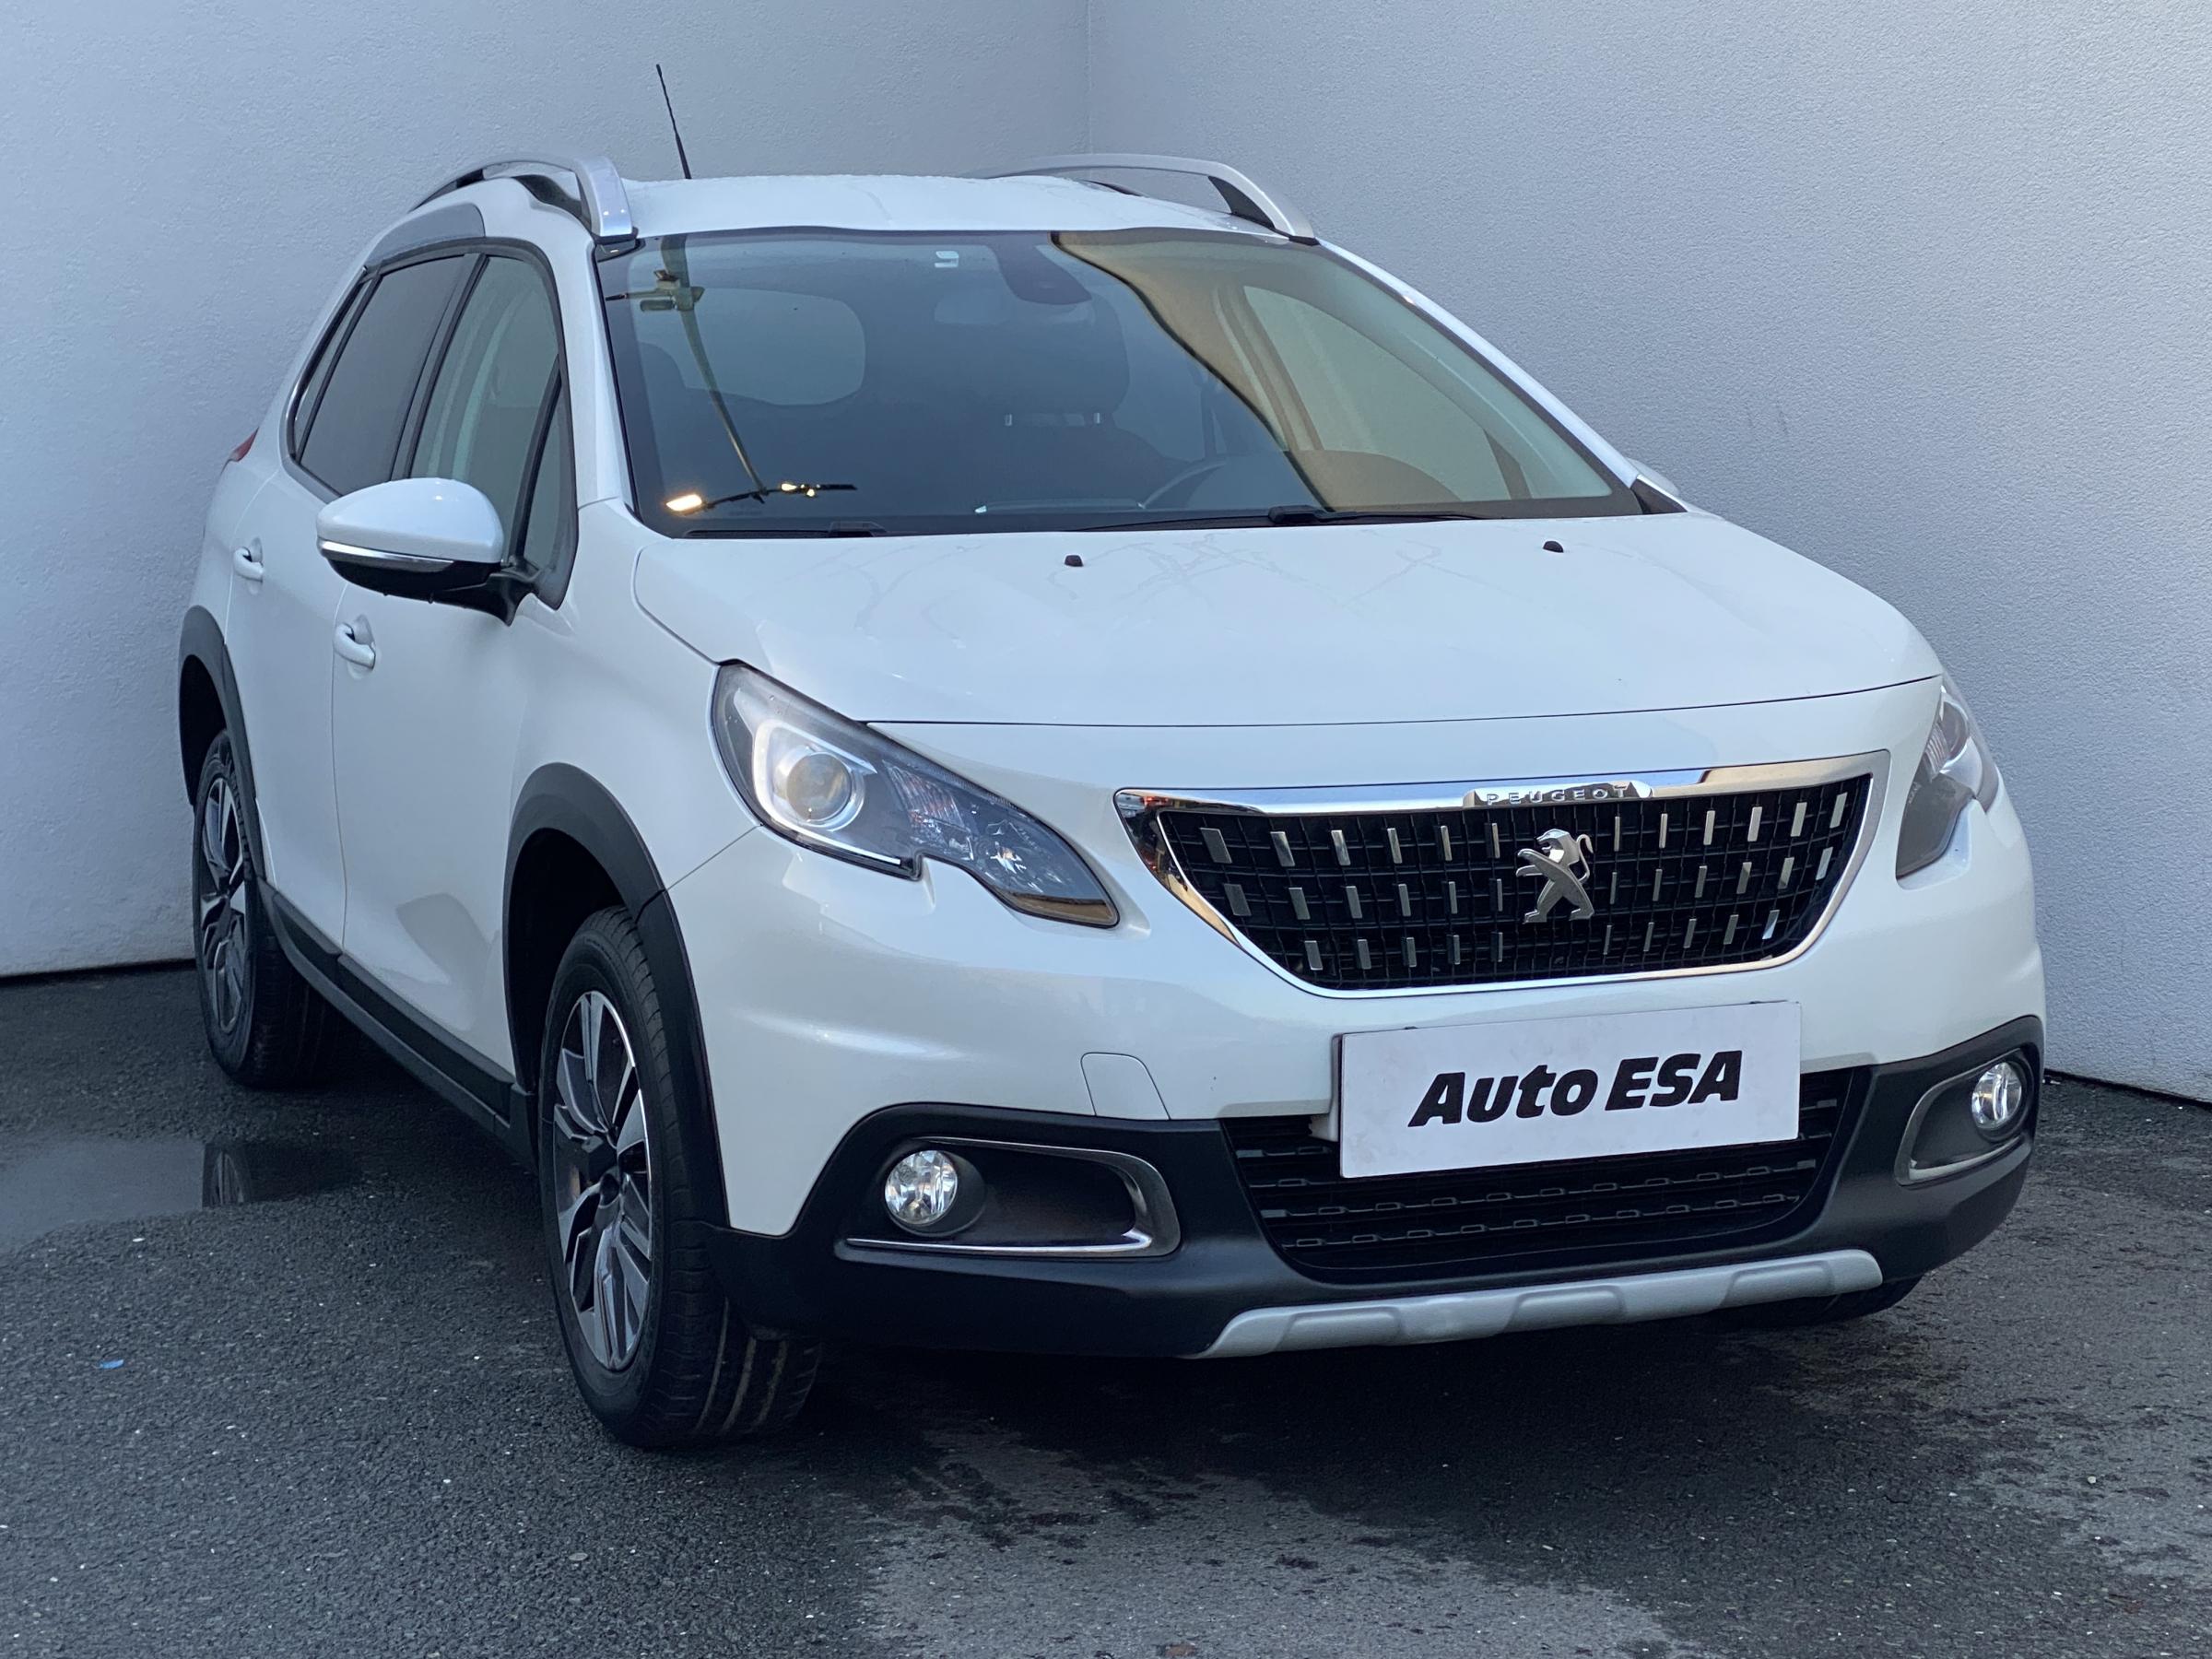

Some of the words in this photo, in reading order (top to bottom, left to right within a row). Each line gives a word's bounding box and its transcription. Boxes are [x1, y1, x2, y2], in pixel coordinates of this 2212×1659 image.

[1487, 785, 1630, 806] PEUGEOT
[1407, 1065, 1598, 1127] Auto
[1605, 1050, 1743, 1111] ESA
